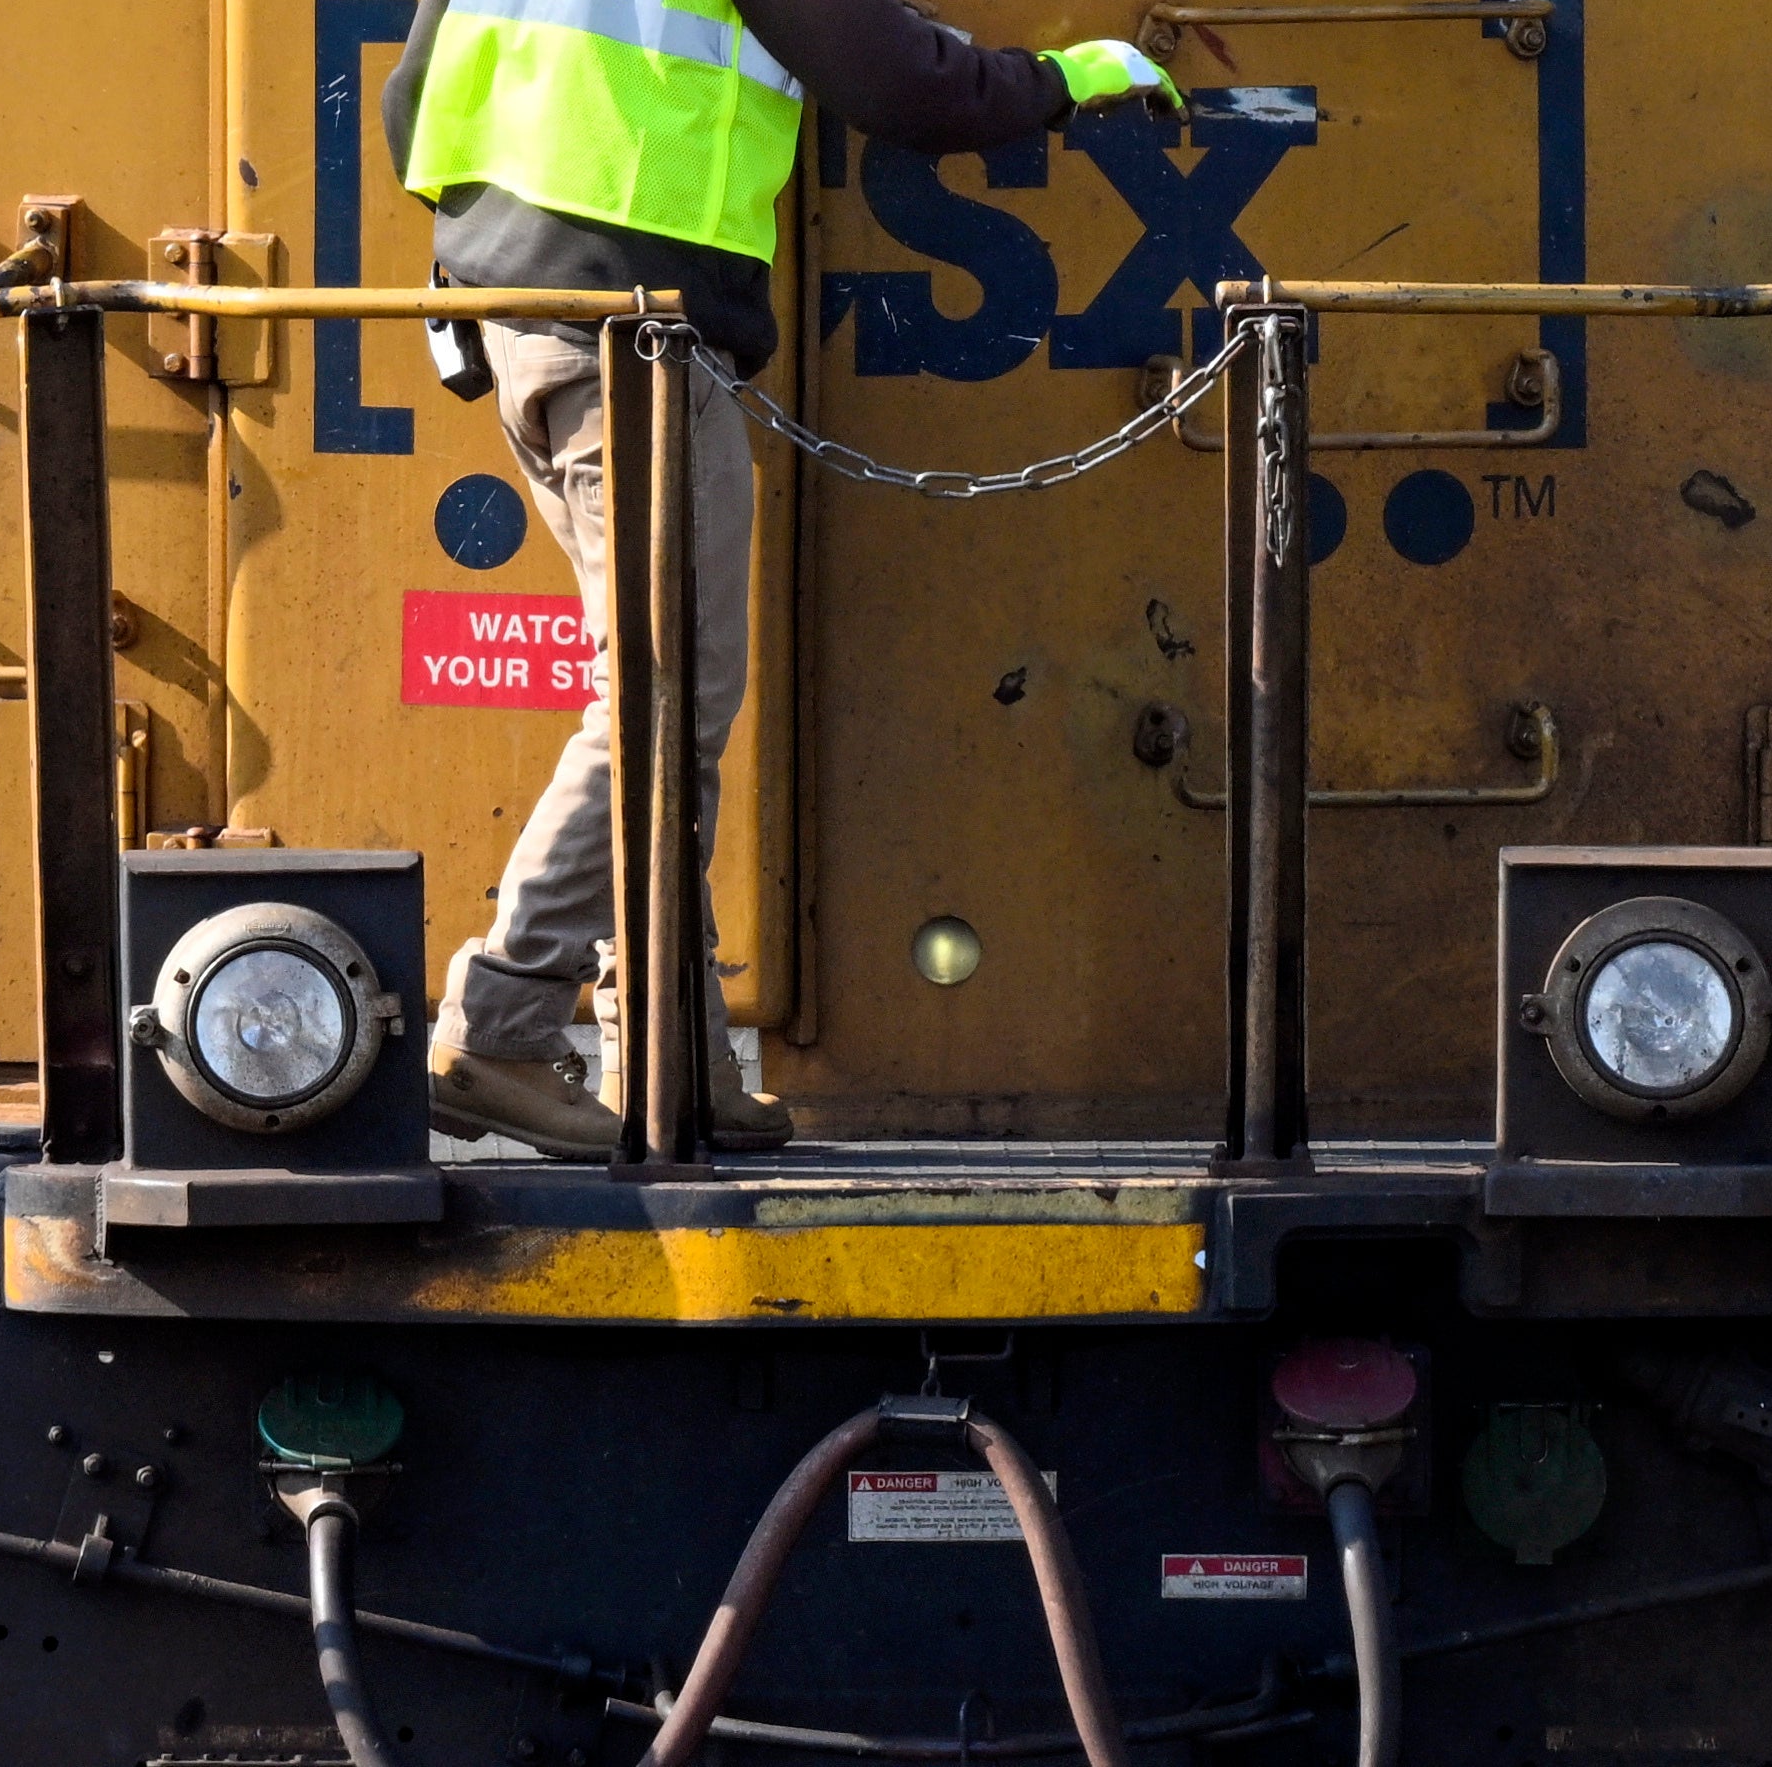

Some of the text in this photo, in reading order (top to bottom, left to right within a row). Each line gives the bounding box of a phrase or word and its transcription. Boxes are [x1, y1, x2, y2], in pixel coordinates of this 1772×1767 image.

[819, 86, 1320, 381] SX
[1482, 474, 1555, 519] TM
[423, 655, 596, 691] YOUR ST
[876, 1477, 933, 1489] DANGER
[954, 1477, 982, 1488] HIGH
[1224, 1561, 1279, 1573] DANGER
[1193, 1579, 1275, 1590] HIGH VOLTAGE
